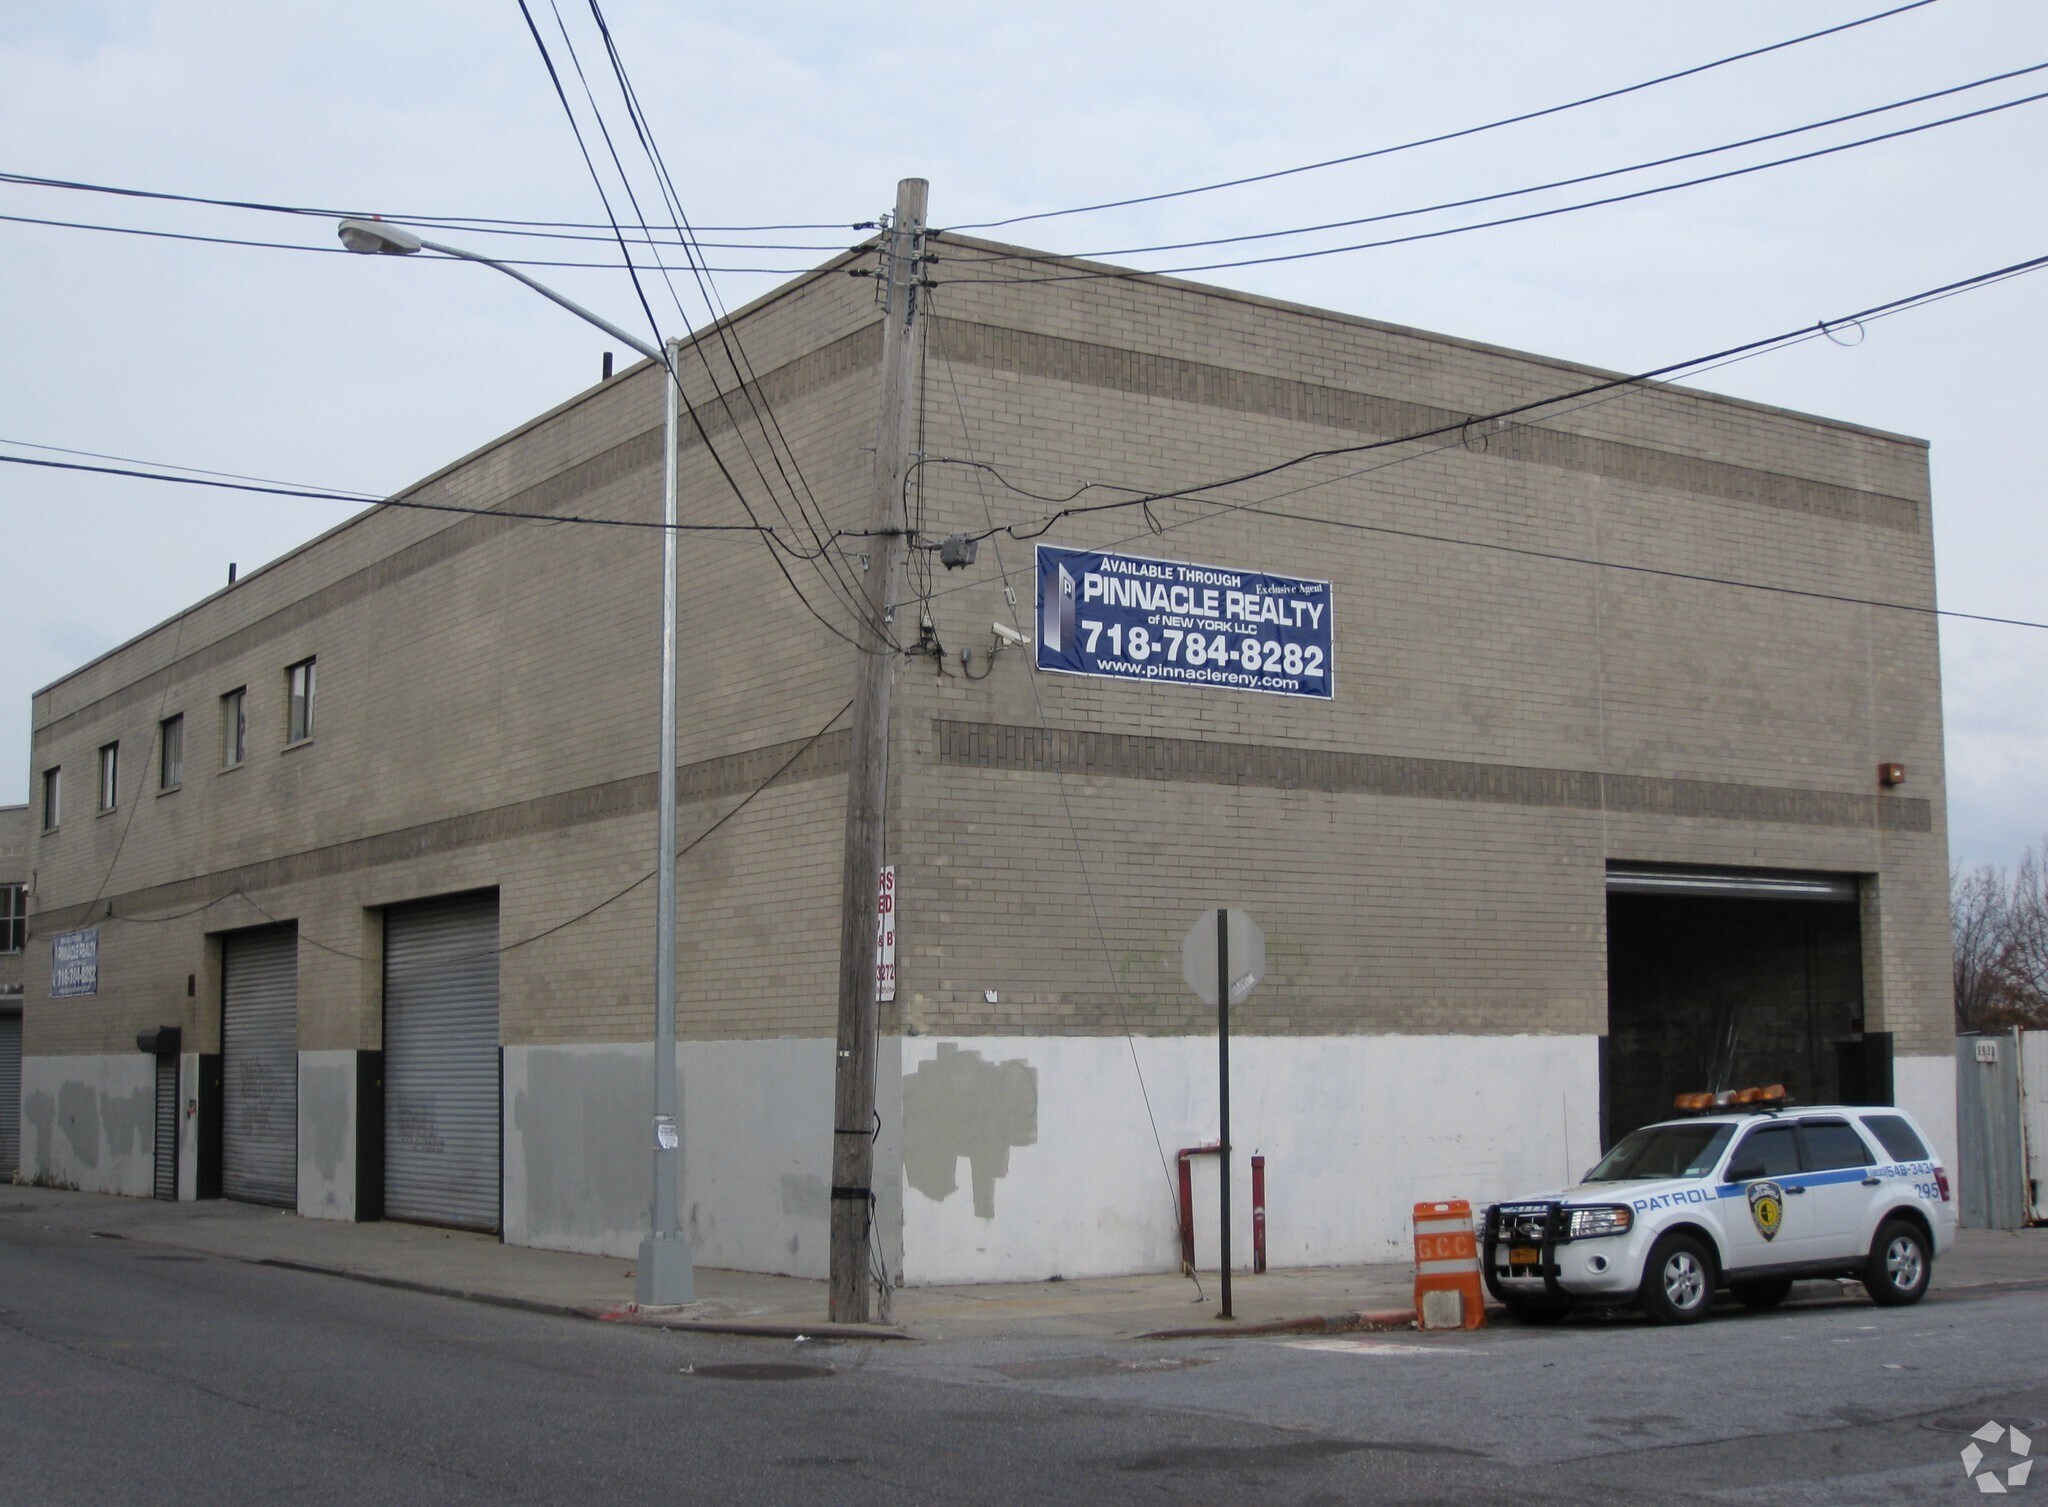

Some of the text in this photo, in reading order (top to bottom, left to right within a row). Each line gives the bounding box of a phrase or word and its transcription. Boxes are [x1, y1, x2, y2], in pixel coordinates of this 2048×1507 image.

[1100, 557, 1241, 588] AVAILABLE THROUGH
[1083, 572, 1324, 630] PINNACLE REALTY
[1256, 583, 1323, 595] Exclusive Agent
[1148, 615, 1258, 635] of NEW YORK LLC
[1081, 620, 1324, 677] 718-784-8282
[1096, 658, 1299, 690] www.pinnaclereny.com
[1632, 1189, 1716, 1214] PATROL
[1914, 1182, 1939, 1198] 295
[1418, 1236, 1467, 1258] GCC
